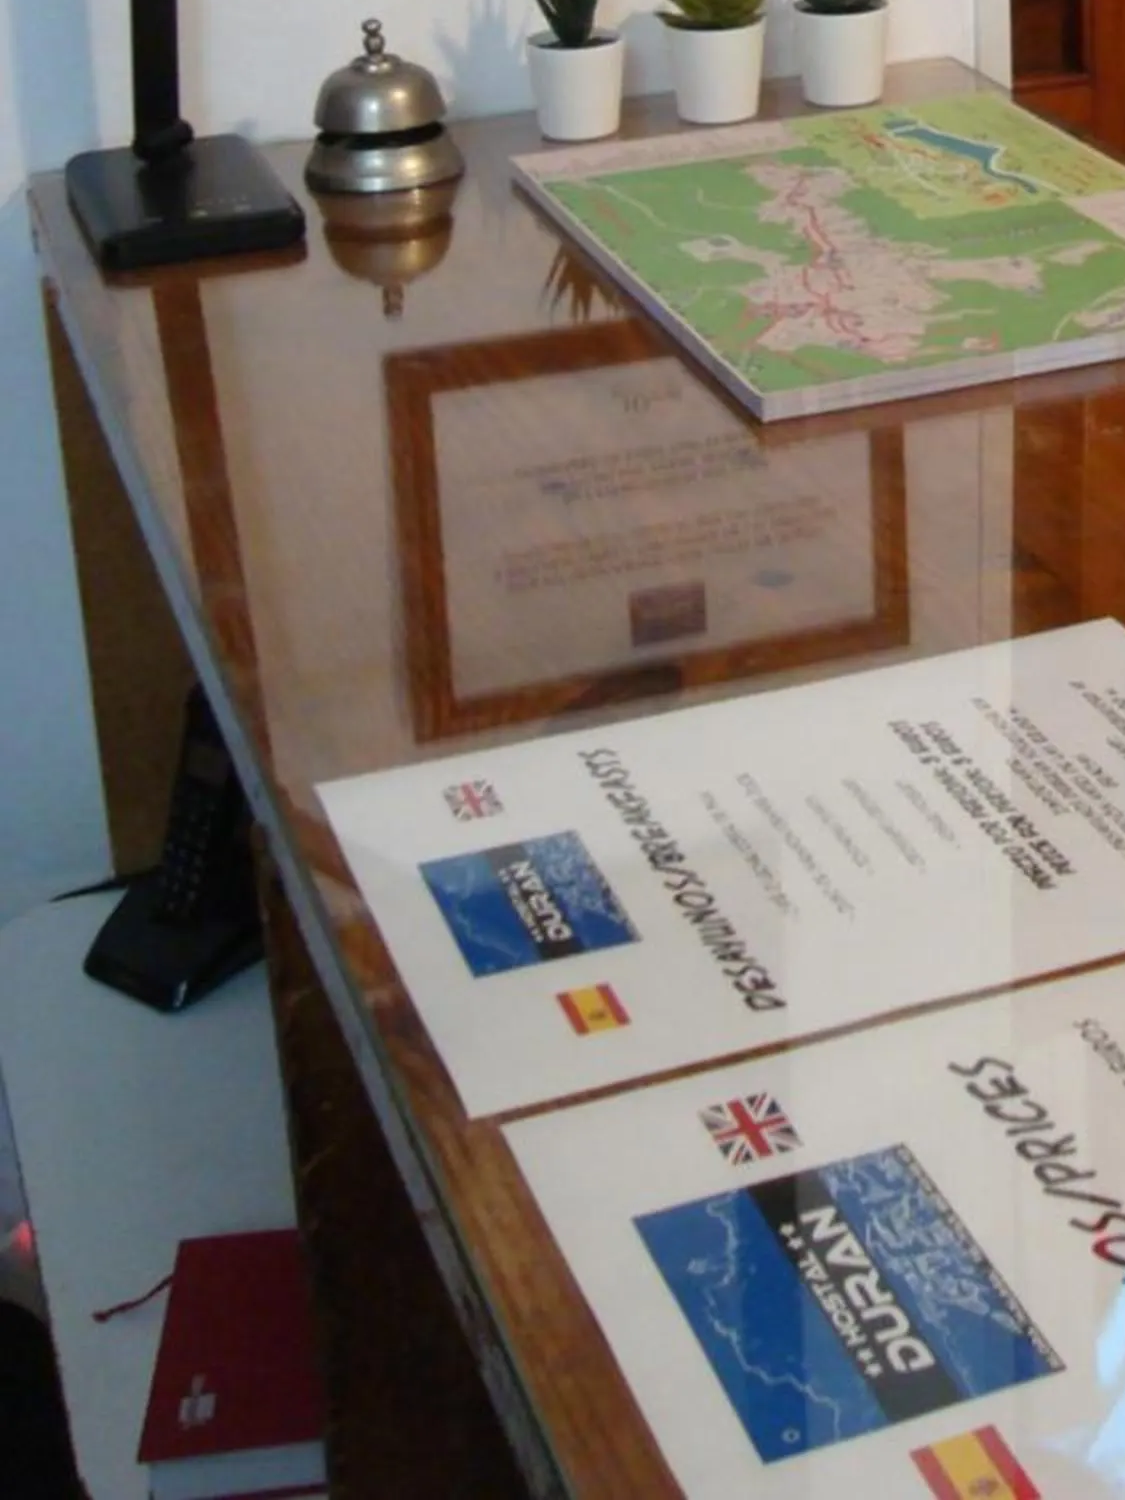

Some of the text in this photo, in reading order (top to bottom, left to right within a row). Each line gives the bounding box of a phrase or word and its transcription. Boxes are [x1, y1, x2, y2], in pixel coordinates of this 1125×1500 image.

[506, 858, 573, 941] DURAN
[580, 748, 787, 1014] DESAYUNOS/BREAKFASTS
[792, 1252, 871, 1346] HOSTAL
[795, 1205, 940, 1372] DURAN
